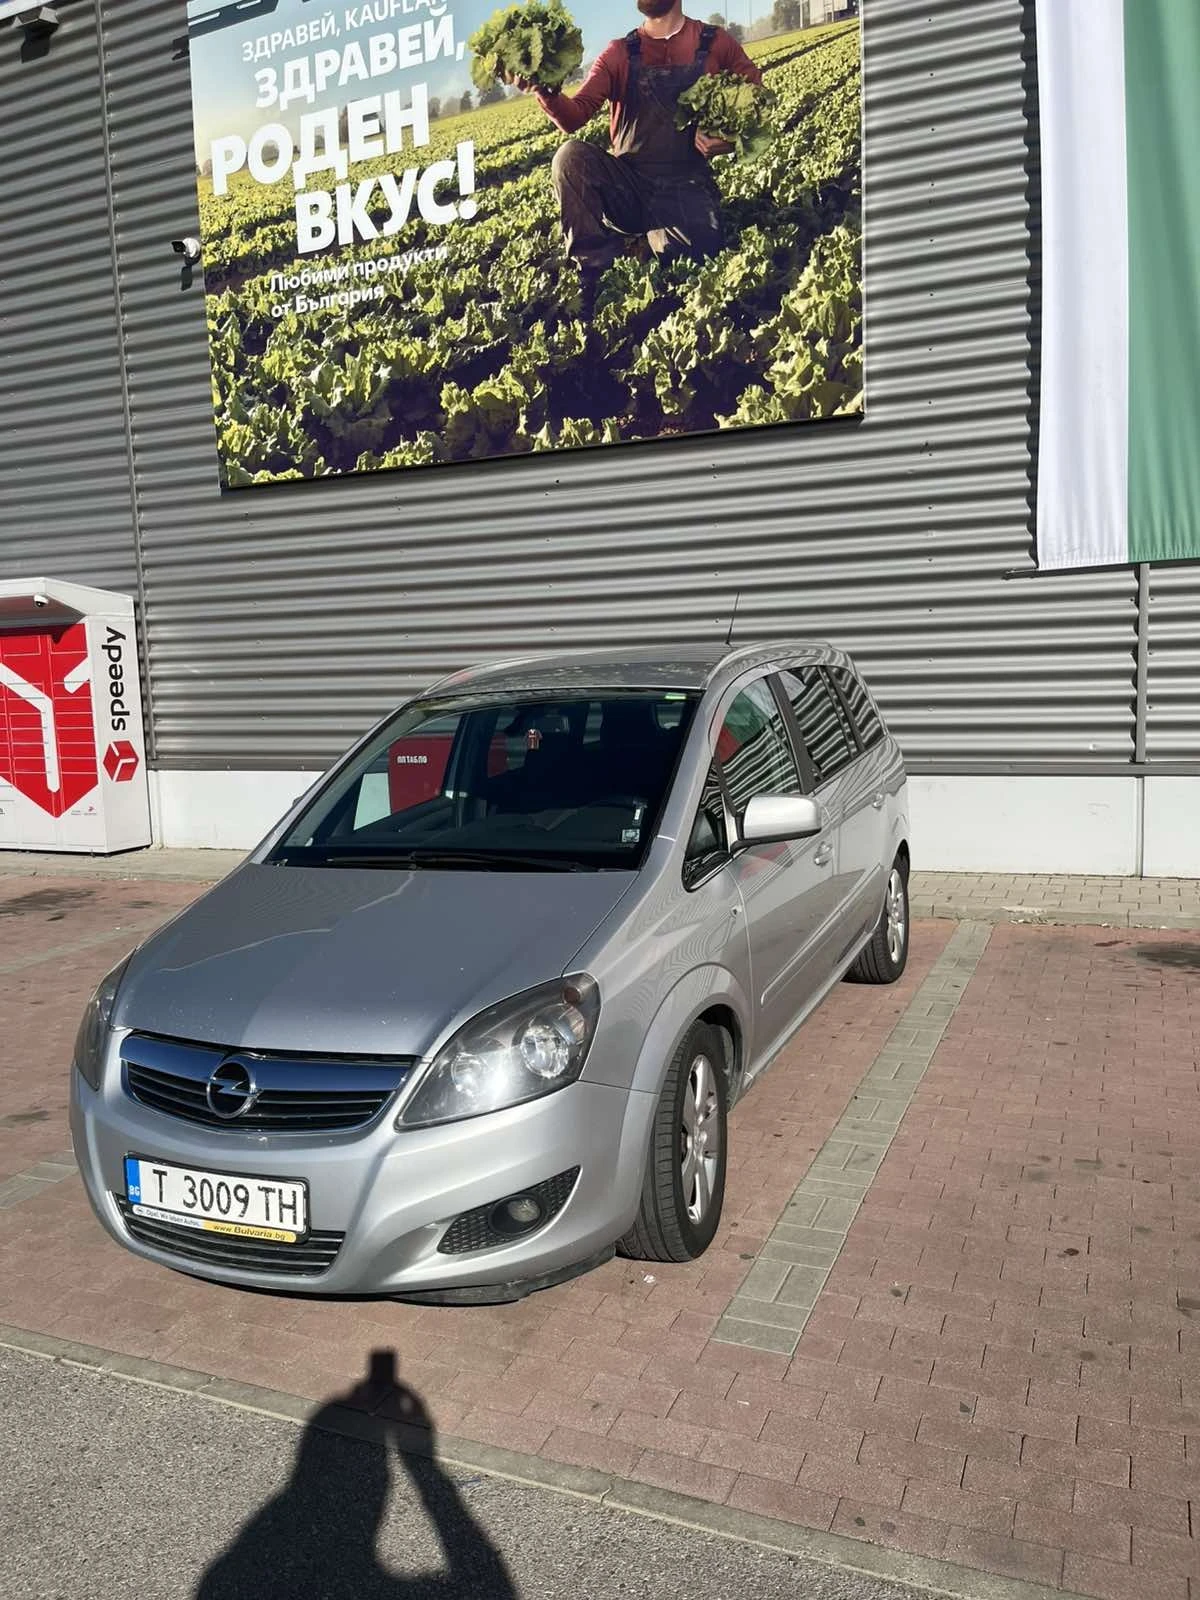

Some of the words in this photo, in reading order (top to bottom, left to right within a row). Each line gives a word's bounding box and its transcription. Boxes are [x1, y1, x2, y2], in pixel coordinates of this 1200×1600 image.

[242, 11, 340, 62] ЗДРАВЕЙ,
[345, 0, 447, 31] KAUFL
[254, 3, 465, 111] ЗДРАВЕЙ,
[210, 82, 430, 196] РОДЕН
[295, 140, 477, 254] ВКУС!
[269, 265, 349, 293] Любими
[353, 247, 448, 281] продукти
[271, 302, 290, 318] от
[295, 285, 384, 314] България
[102, 626, 130, 731] speedy
[128, 1185, 141, 1197] BG
[152, 1169, 167, 1203] T
[183, 1174, 250, 1218] 3009
[258, 1185, 298, 1226] TH
